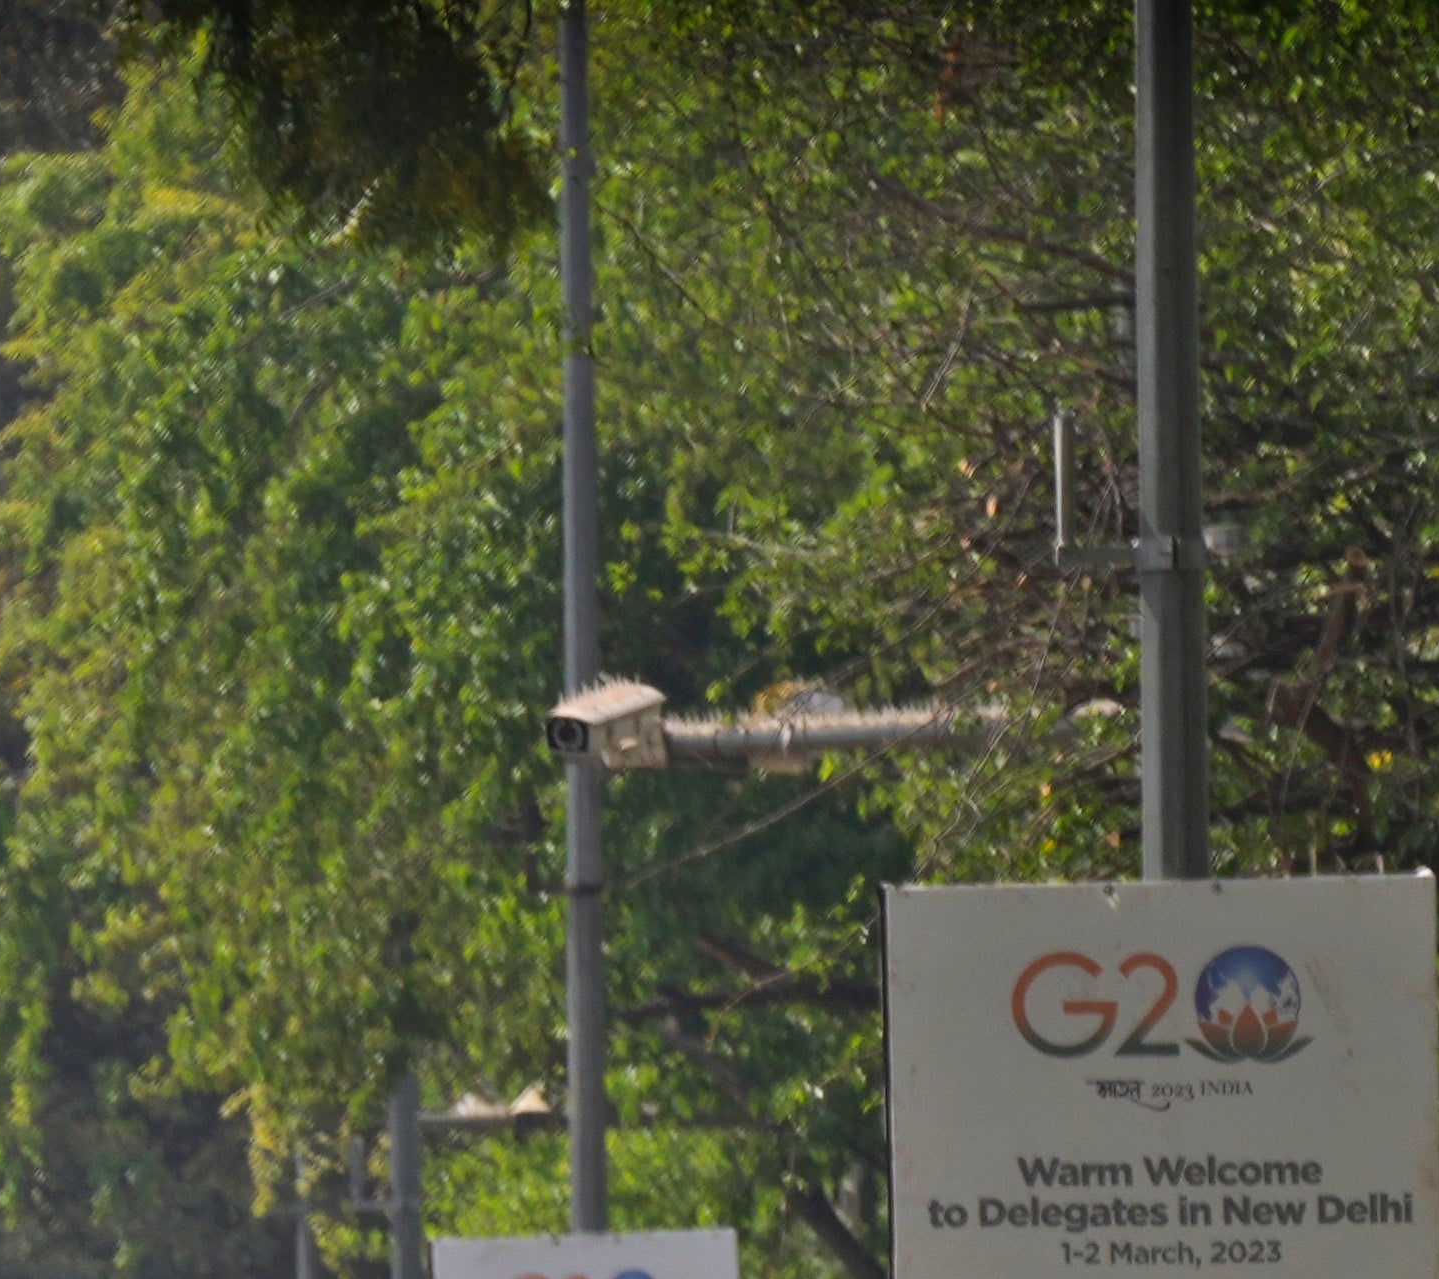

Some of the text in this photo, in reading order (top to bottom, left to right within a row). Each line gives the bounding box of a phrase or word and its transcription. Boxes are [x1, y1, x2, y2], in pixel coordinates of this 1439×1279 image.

[1010, 944, 1315, 1064] G20
[1151, 1082, 1195, 1100] 2023
[1200, 1079, 1253, 1097] INDIA
[1017, 1155, 1322, 1188] Warm Welcome
[929, 1194, 1414, 1232] to Delegates in New Delhi
[1061, 1241, 1282, 1268] 1-2 March, 2023
